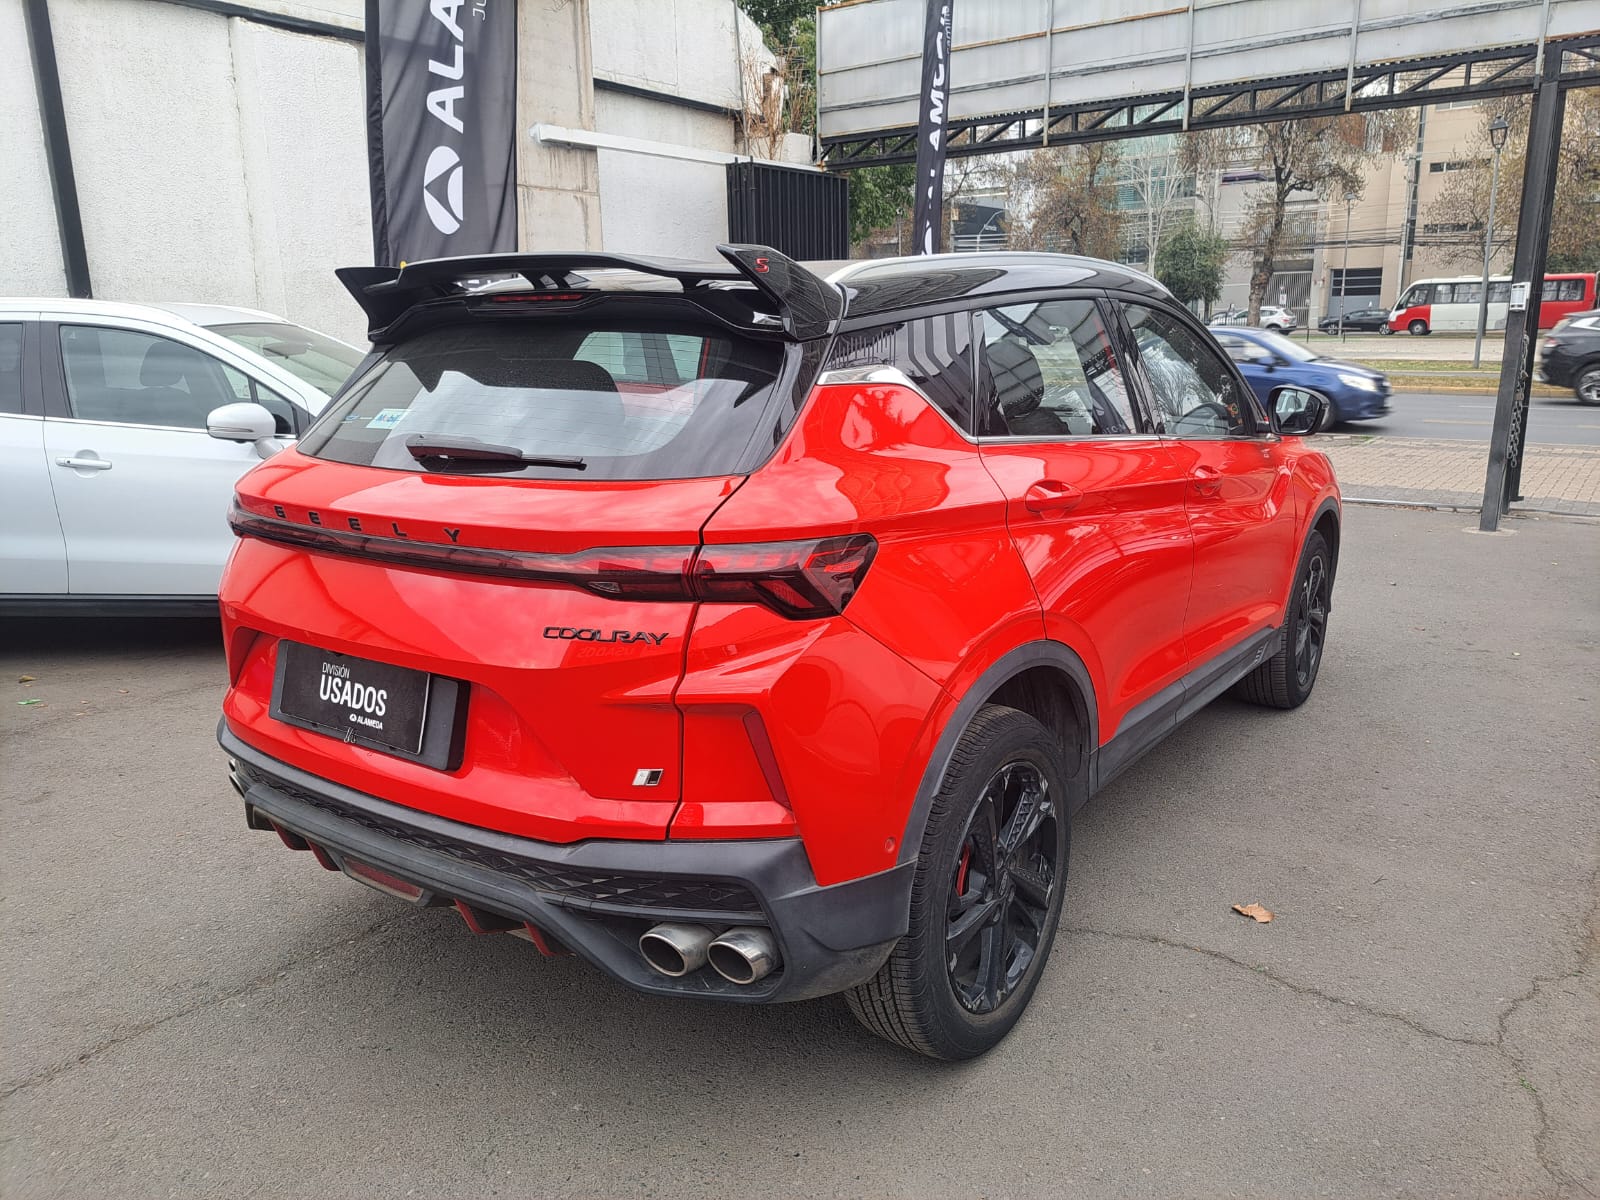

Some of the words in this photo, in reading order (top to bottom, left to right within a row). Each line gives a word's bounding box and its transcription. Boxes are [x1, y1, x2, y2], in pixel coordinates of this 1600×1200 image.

[273, 505, 460, 542] GEELY
[543, 626, 669, 645] COOLRAY
[321, 661, 351, 679] DIVISIÓN
[319, 674, 388, 717] USADOS
[356, 715, 384, 731] ALAMEDA
